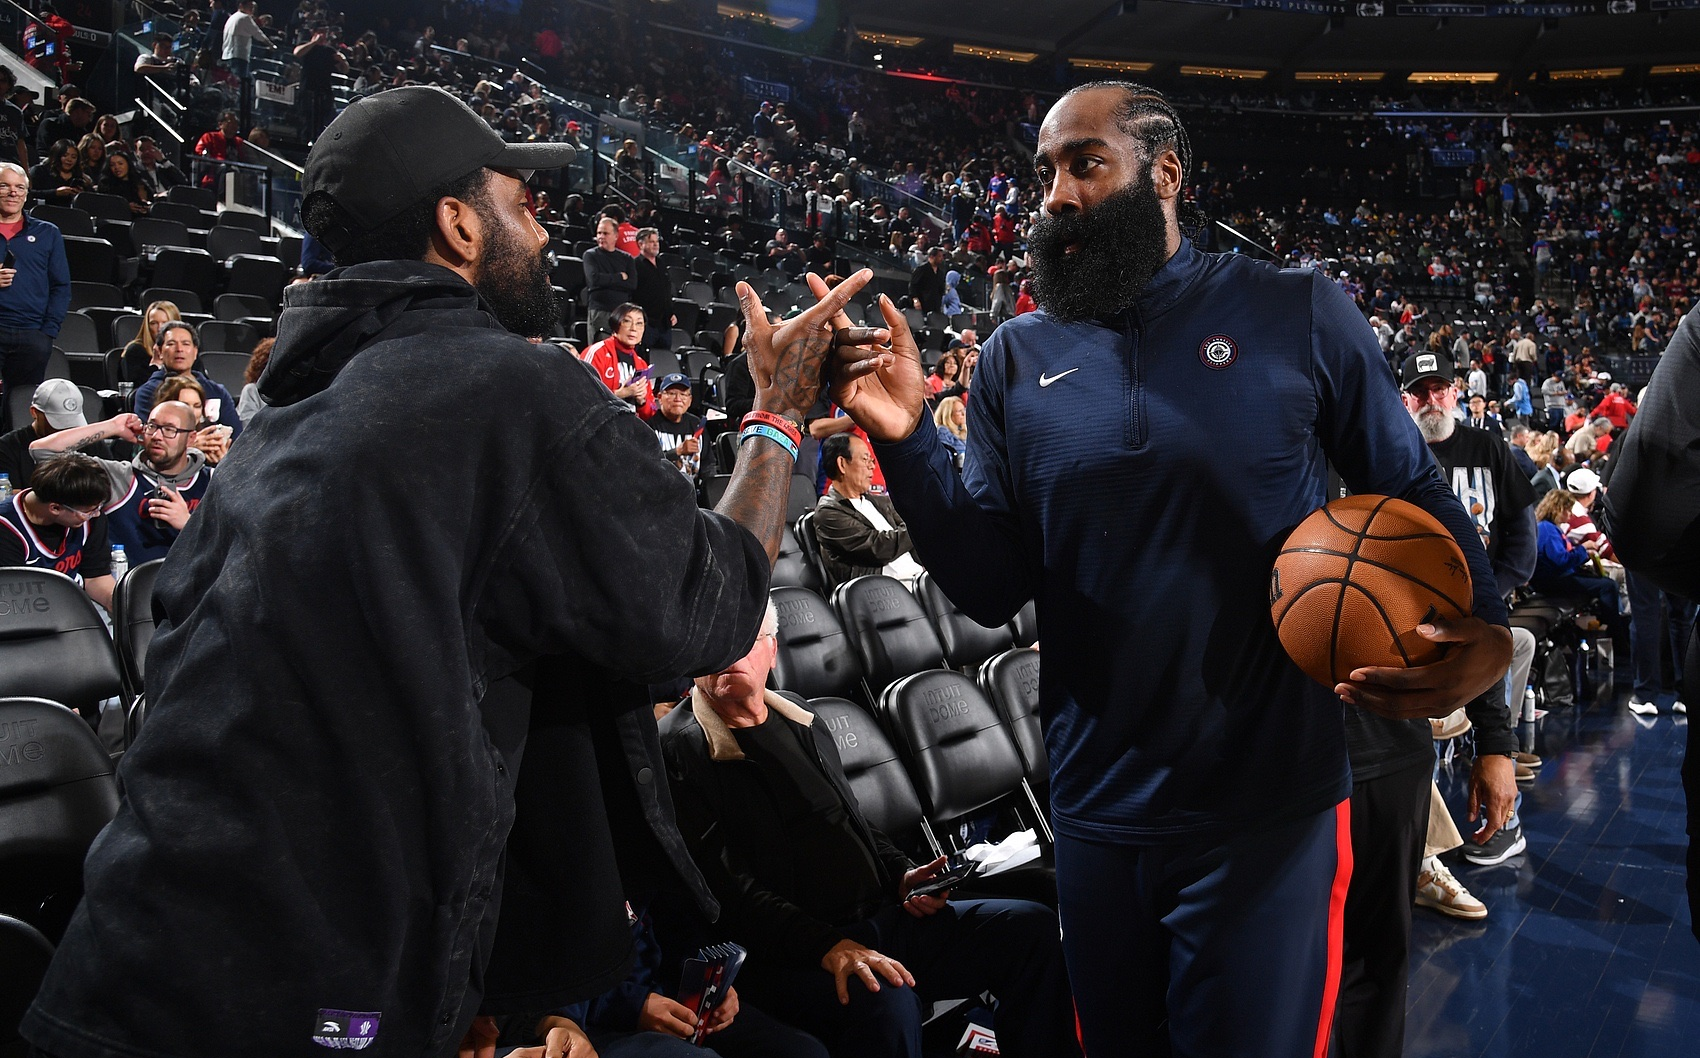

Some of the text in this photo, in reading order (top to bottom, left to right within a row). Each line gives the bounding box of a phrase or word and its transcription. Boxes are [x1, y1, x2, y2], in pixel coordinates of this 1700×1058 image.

[1288, 1, 1345, 13] PLAYOFFS
[1497, 5, 1595, 14] 2025 PLAYOFFS
[771, 415, 785, 426] THE
